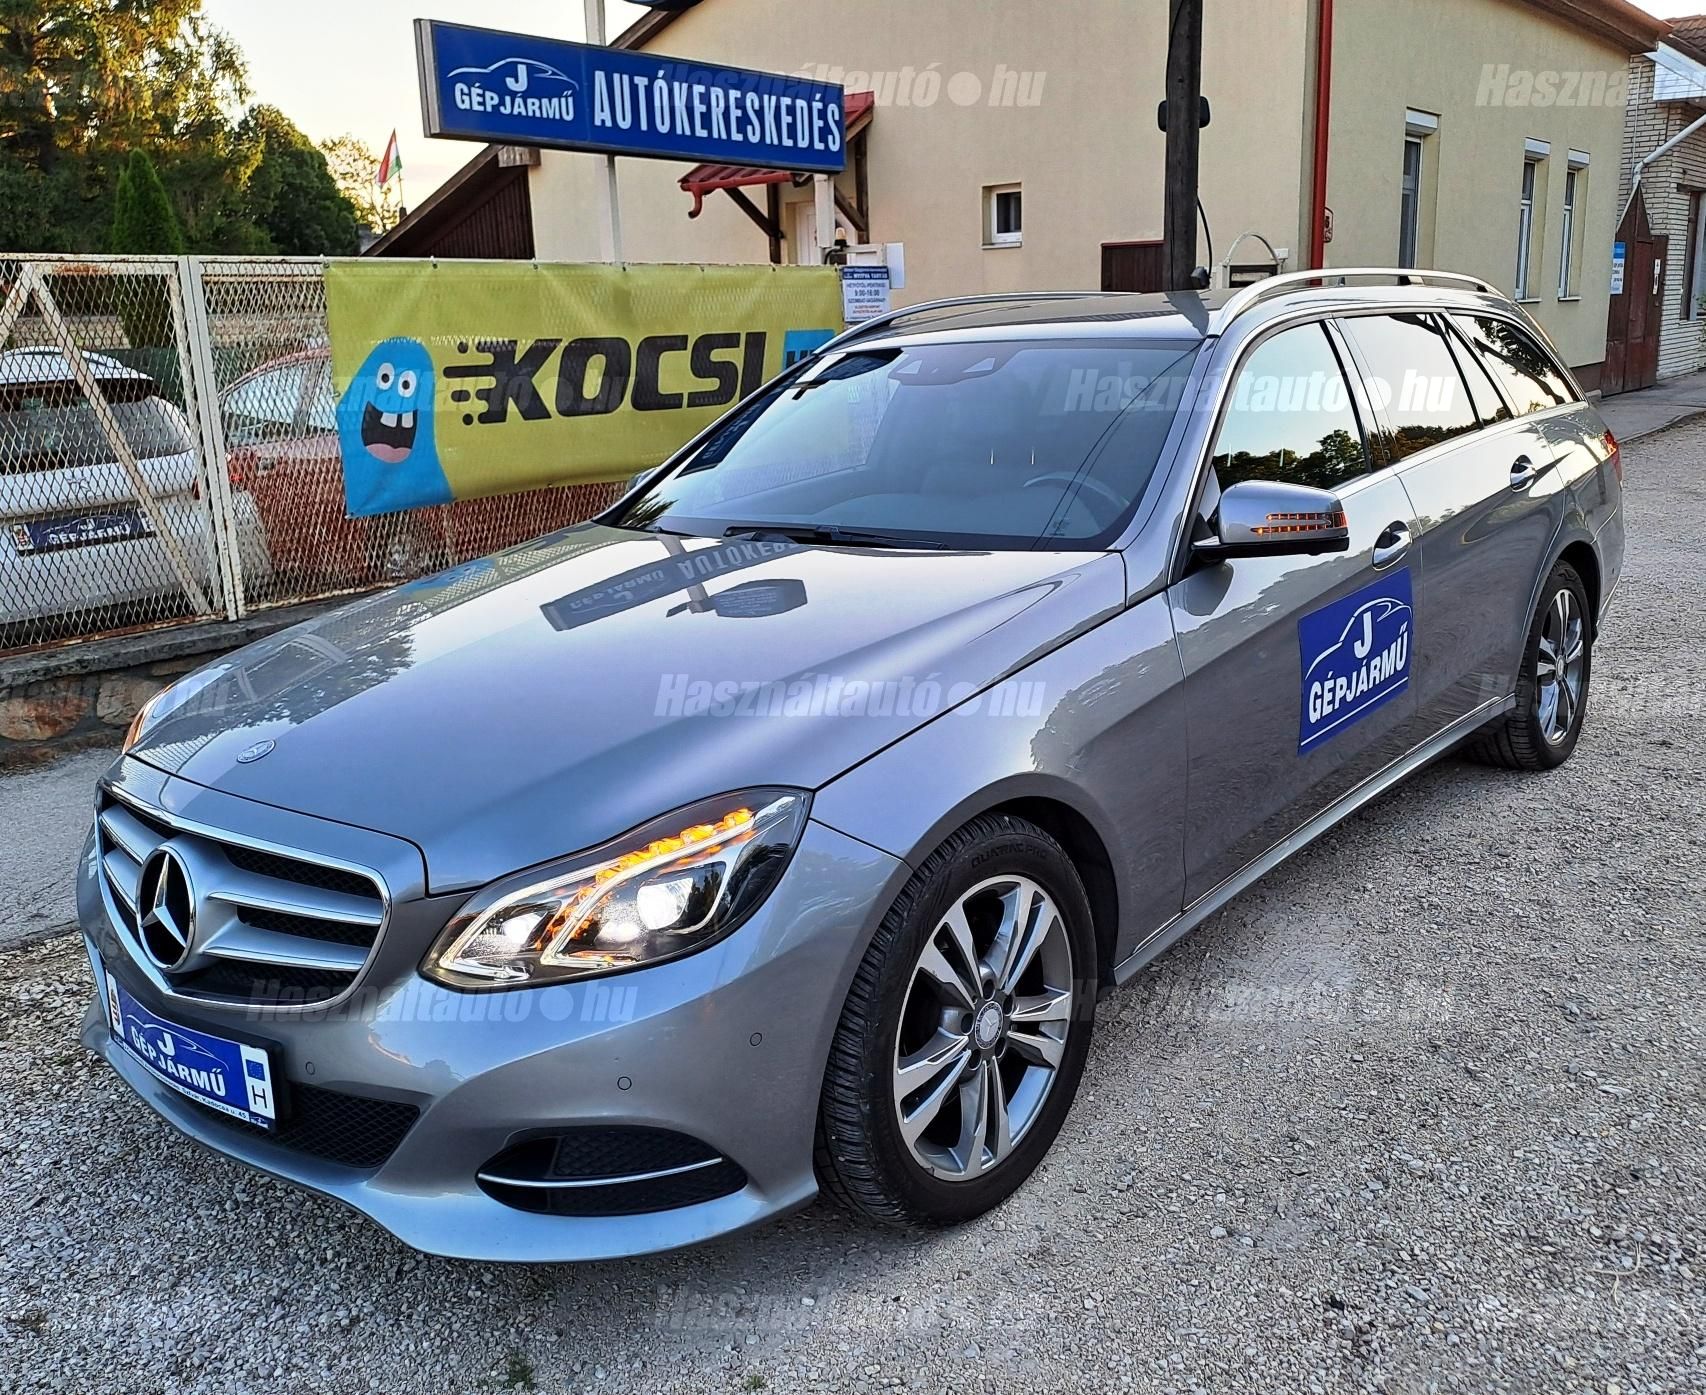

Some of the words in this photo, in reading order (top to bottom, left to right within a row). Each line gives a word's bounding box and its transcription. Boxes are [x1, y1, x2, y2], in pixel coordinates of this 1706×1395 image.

[454, 81, 575, 121] GÉPJÁRMŰ
[505, 63, 528, 92] J
[594, 69, 841, 152] AUTÓKERESKEDÉS
[468, 331, 767, 424] KOCSI
[1354, 611, 1373, 658] J
[1308, 621, 1409, 723] GÉPJÁRMŰ
[131, 1025, 226, 1097] GÉPJÁRMŰ
[157, 1032, 176, 1057] J
[251, 1084, 268, 1110] H
